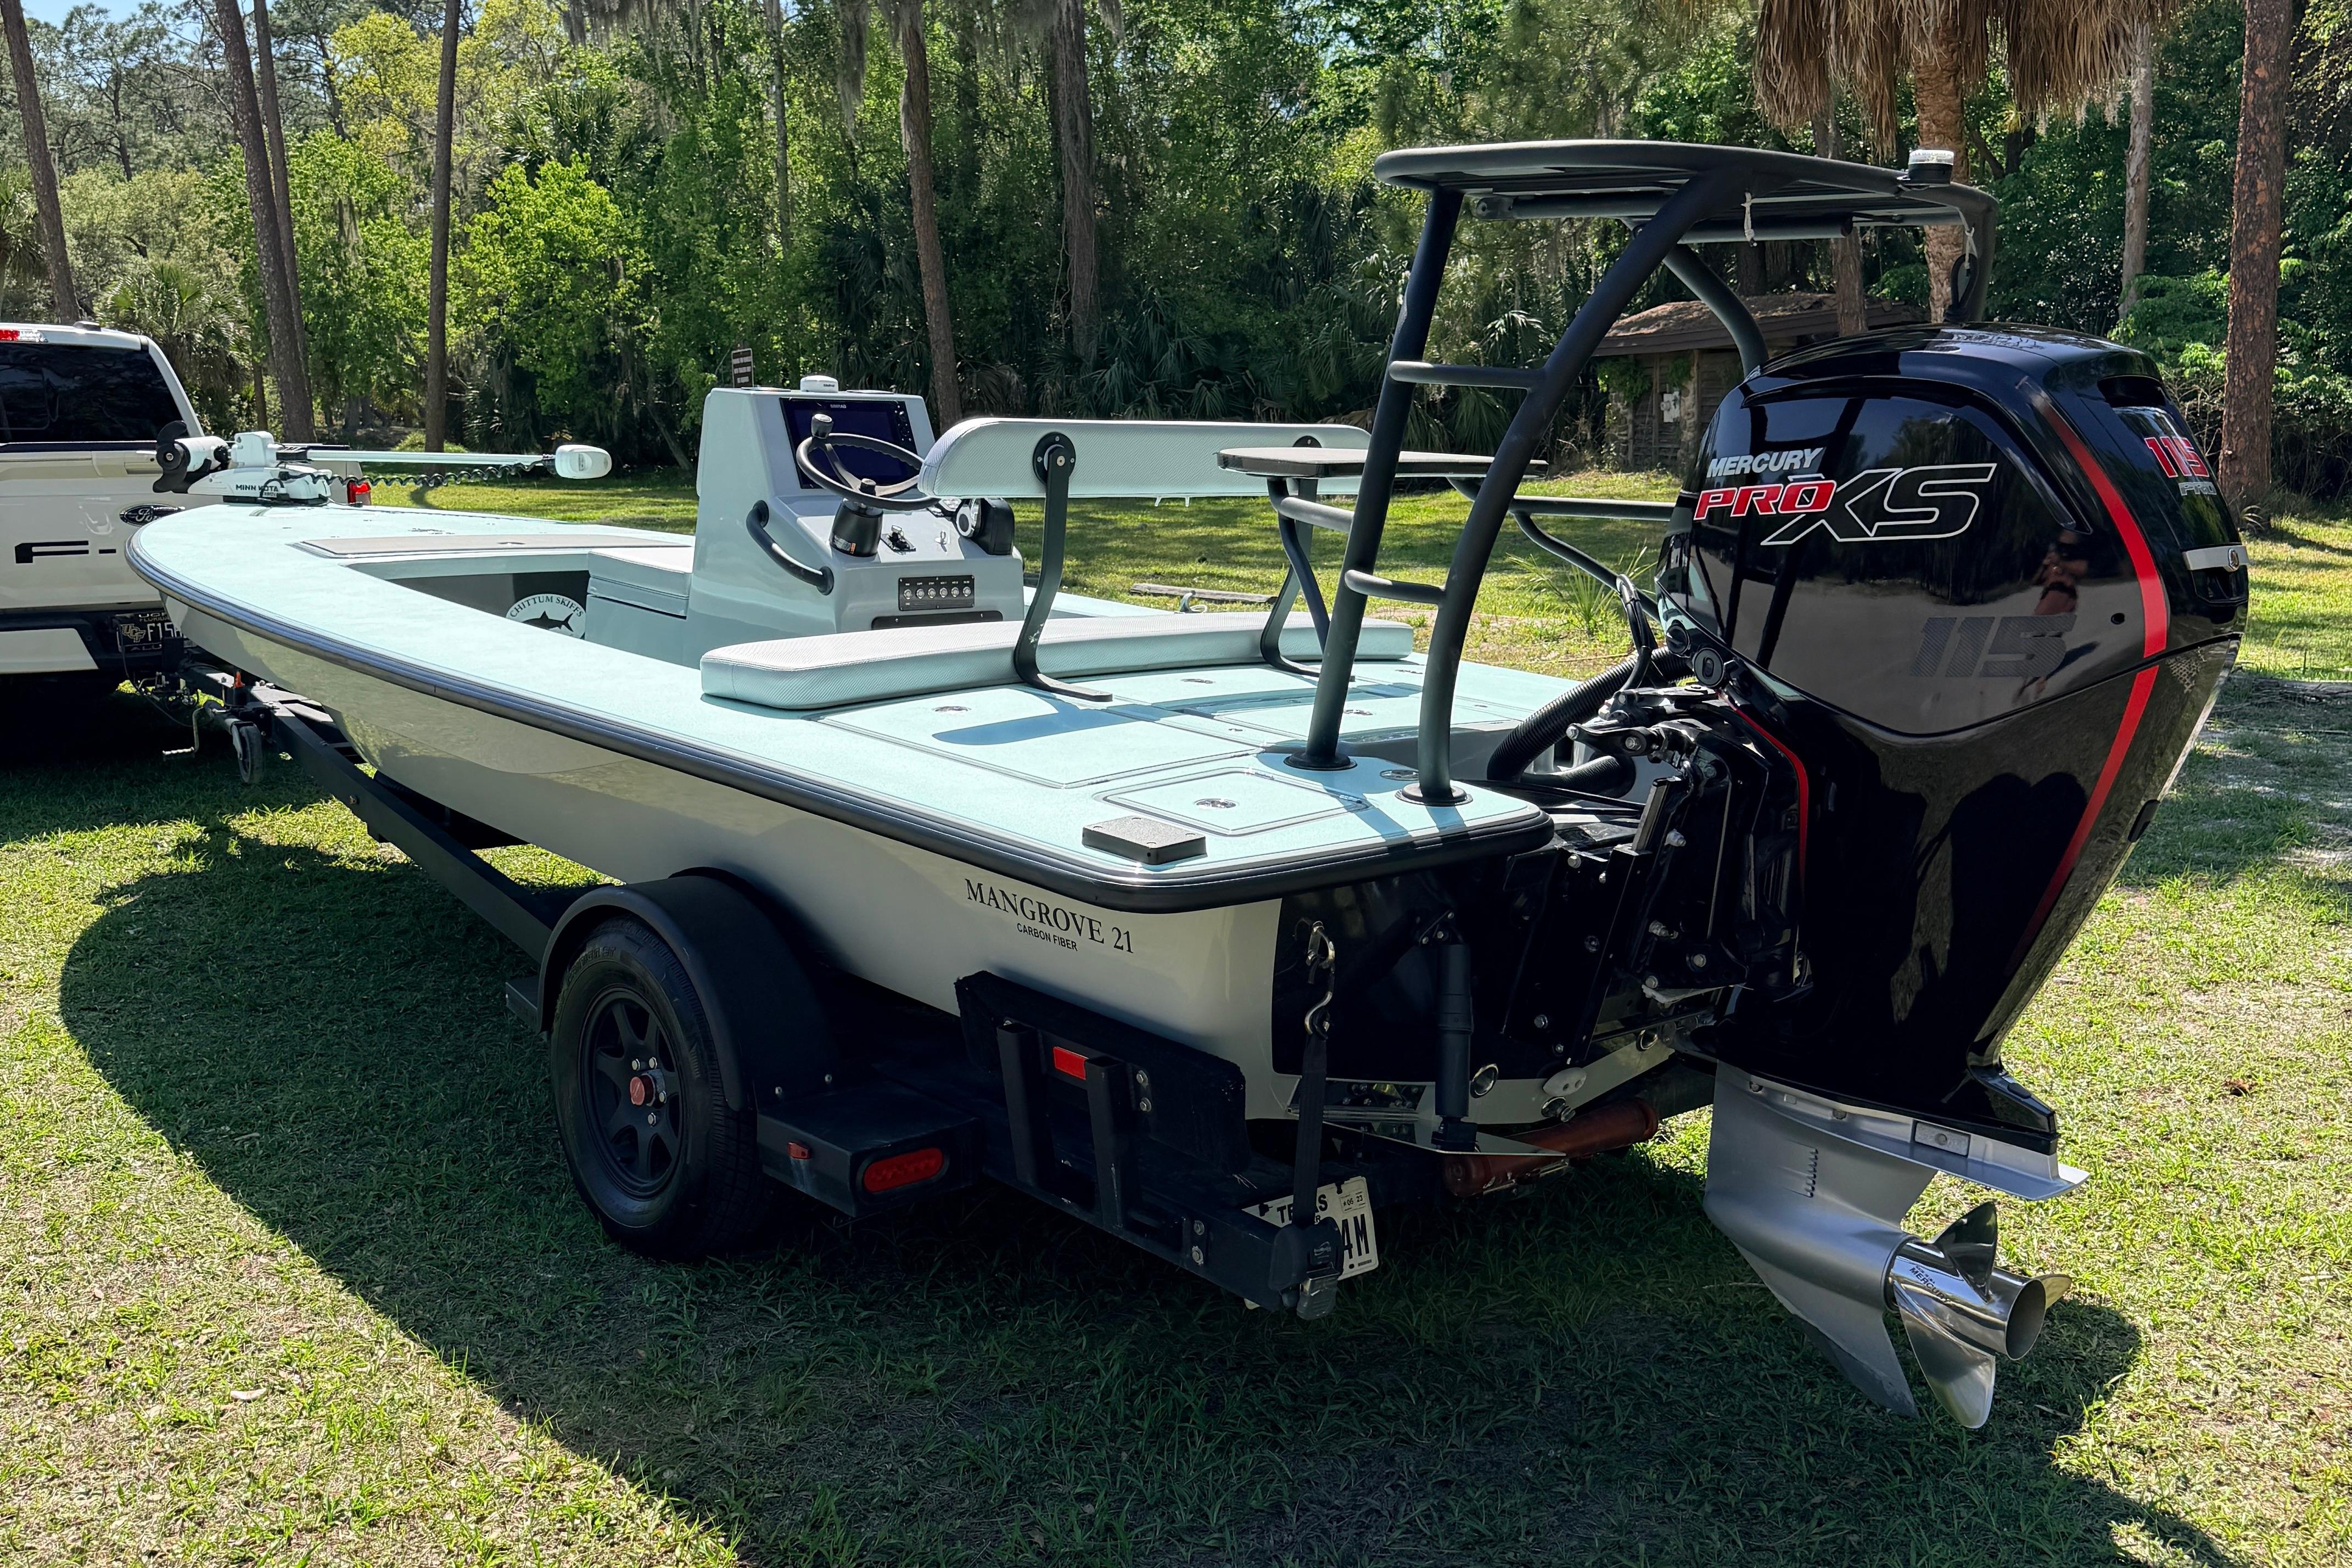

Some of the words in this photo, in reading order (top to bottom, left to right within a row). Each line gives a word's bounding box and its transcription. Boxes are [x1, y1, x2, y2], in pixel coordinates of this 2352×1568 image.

[1706, 447, 1824, 478] MERCURY
[2144, 436, 2210, 478] 115
[1693, 478, 1837, 520] PRO
[1760, 463, 1997, 545] XS
[509, 596, 553, 617] CHITTUM
[556, 596, 584, 617] SKIFFS
[1909, 614, 2077, 677] 115
[965, 878, 1105, 944] MANGROVE
[1111, 926, 1134, 954] 21
[1017, 922, 1051, 943] CARBON
[1053, 934, 1078, 951] FIBER
[1276, 1194, 1328, 1224] TES
